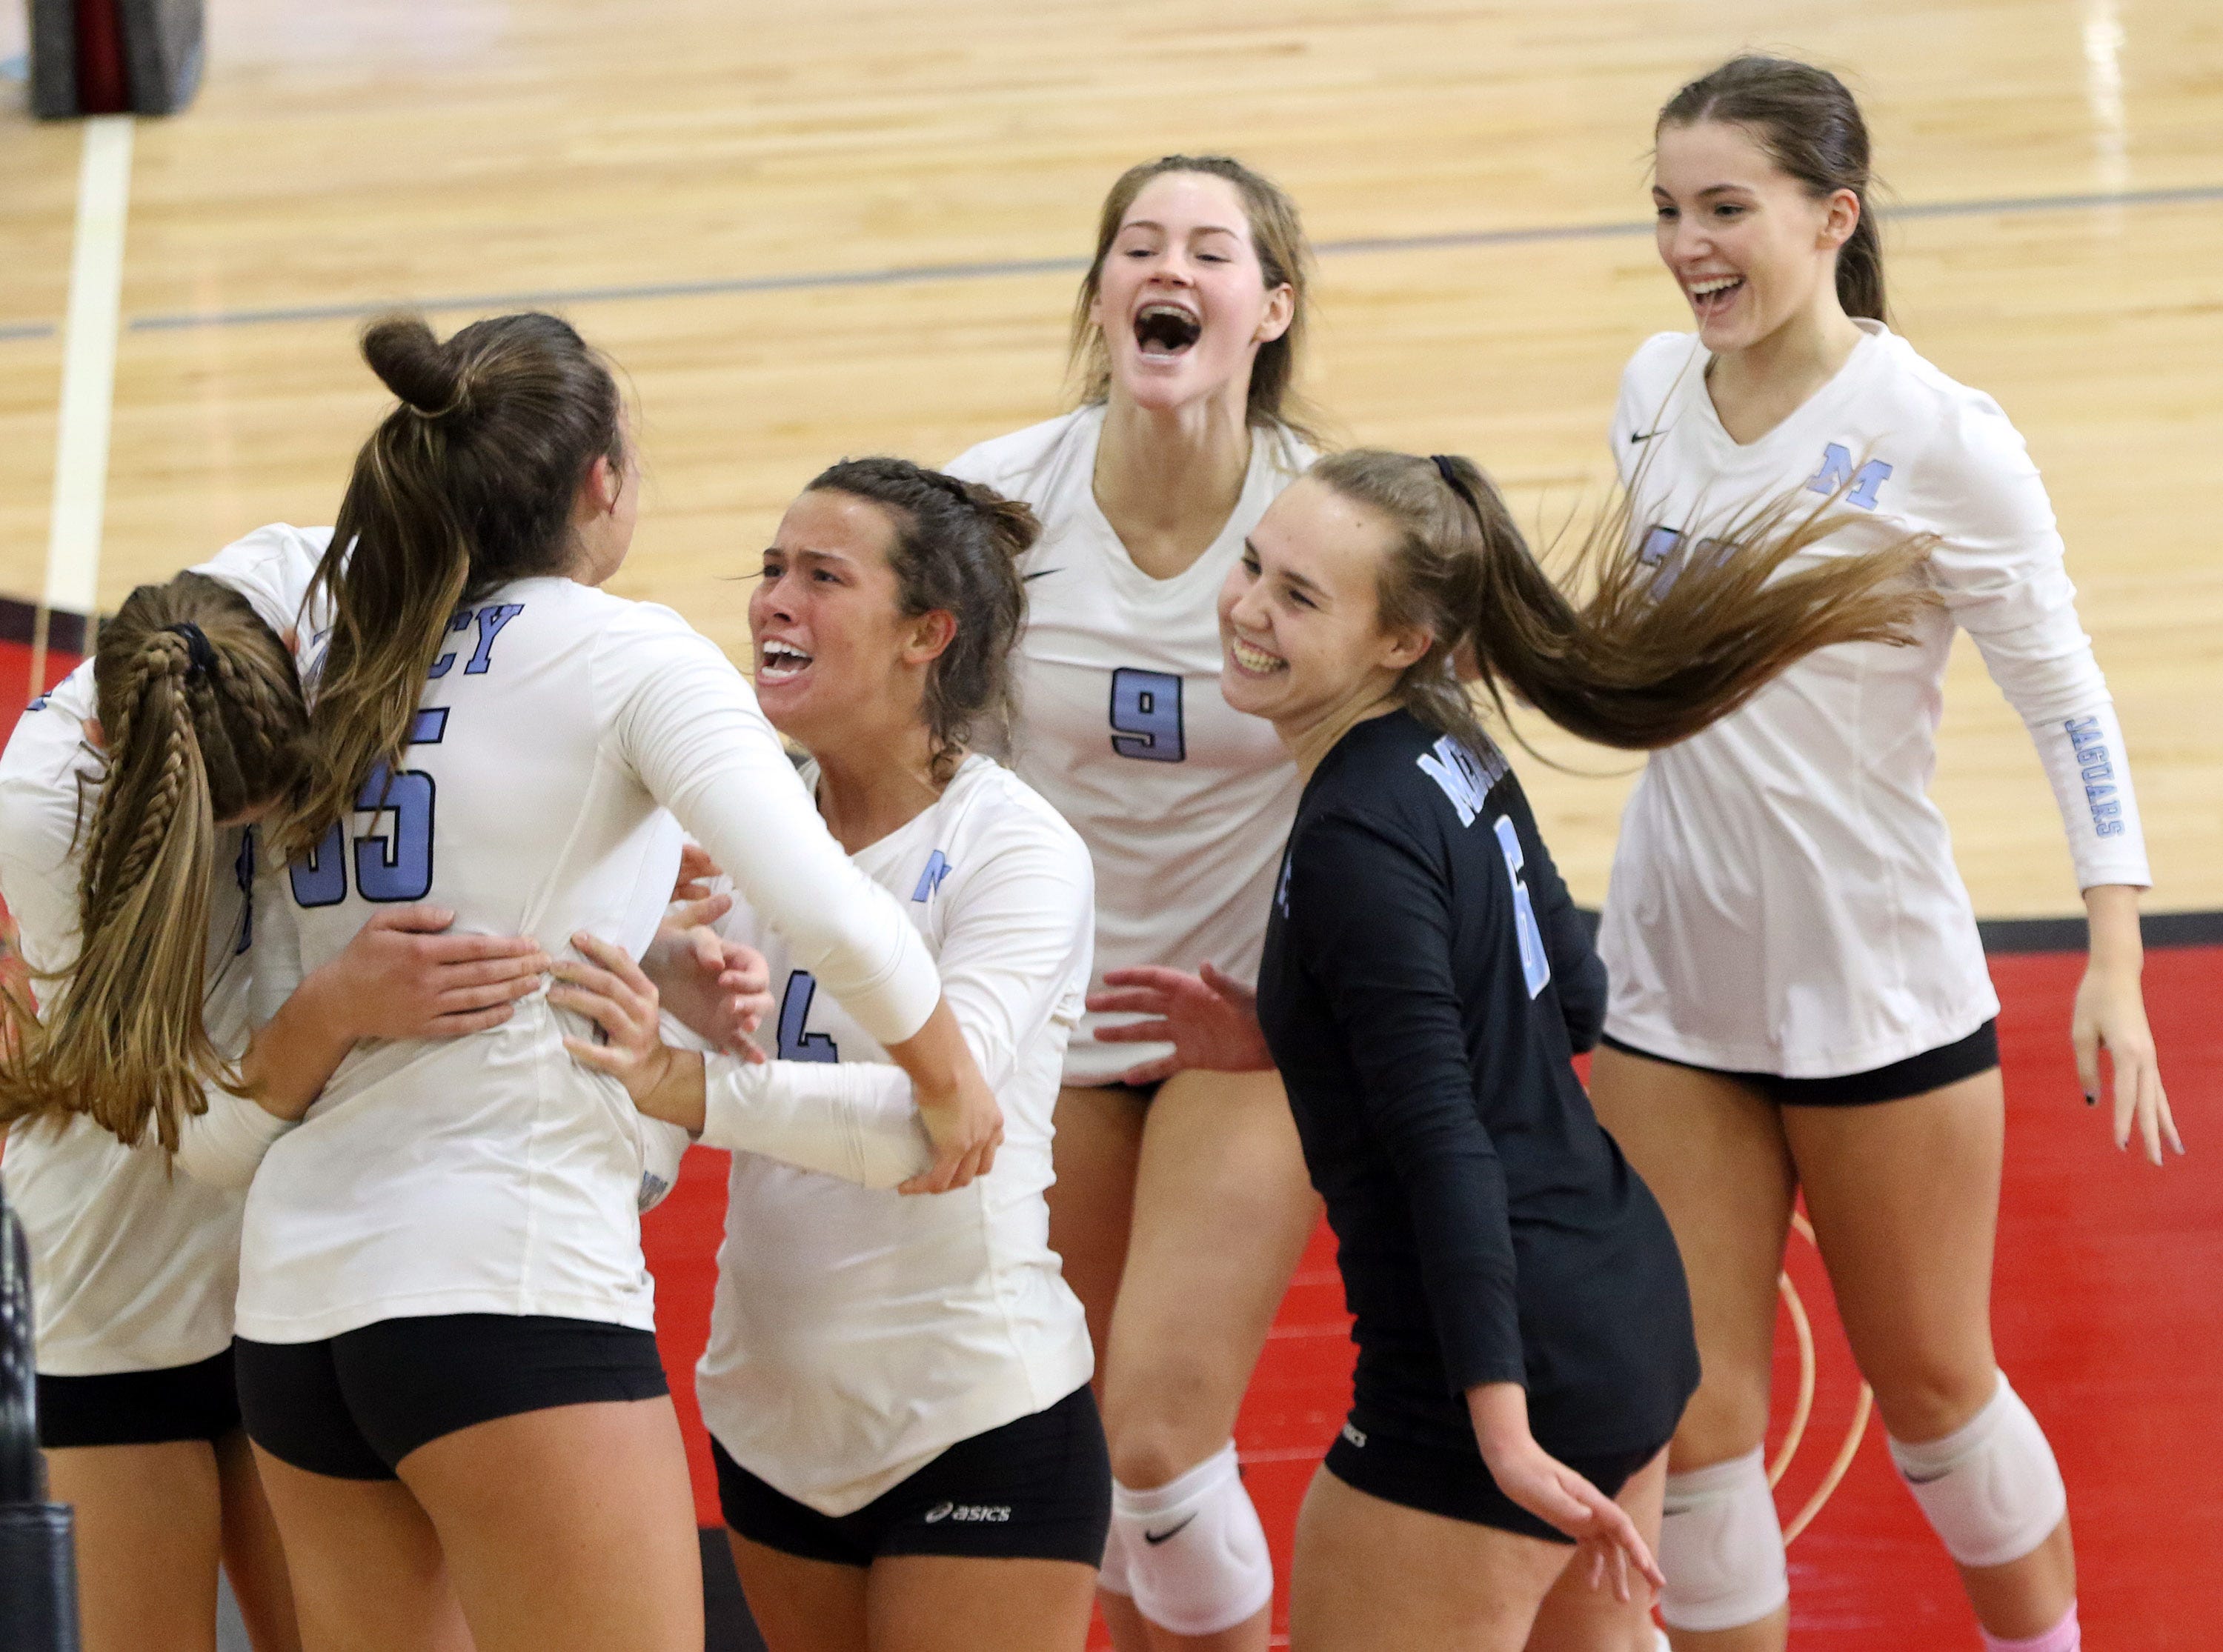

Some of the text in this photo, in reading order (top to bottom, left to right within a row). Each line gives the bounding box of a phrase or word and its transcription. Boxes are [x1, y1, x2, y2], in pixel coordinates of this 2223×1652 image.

[1806, 442, 1893, 511] M
[1110, 667, 1185, 762] 9
[2064, 716, 2125, 838] JAGUARS
[1493, 814, 1550, 1000] 6
